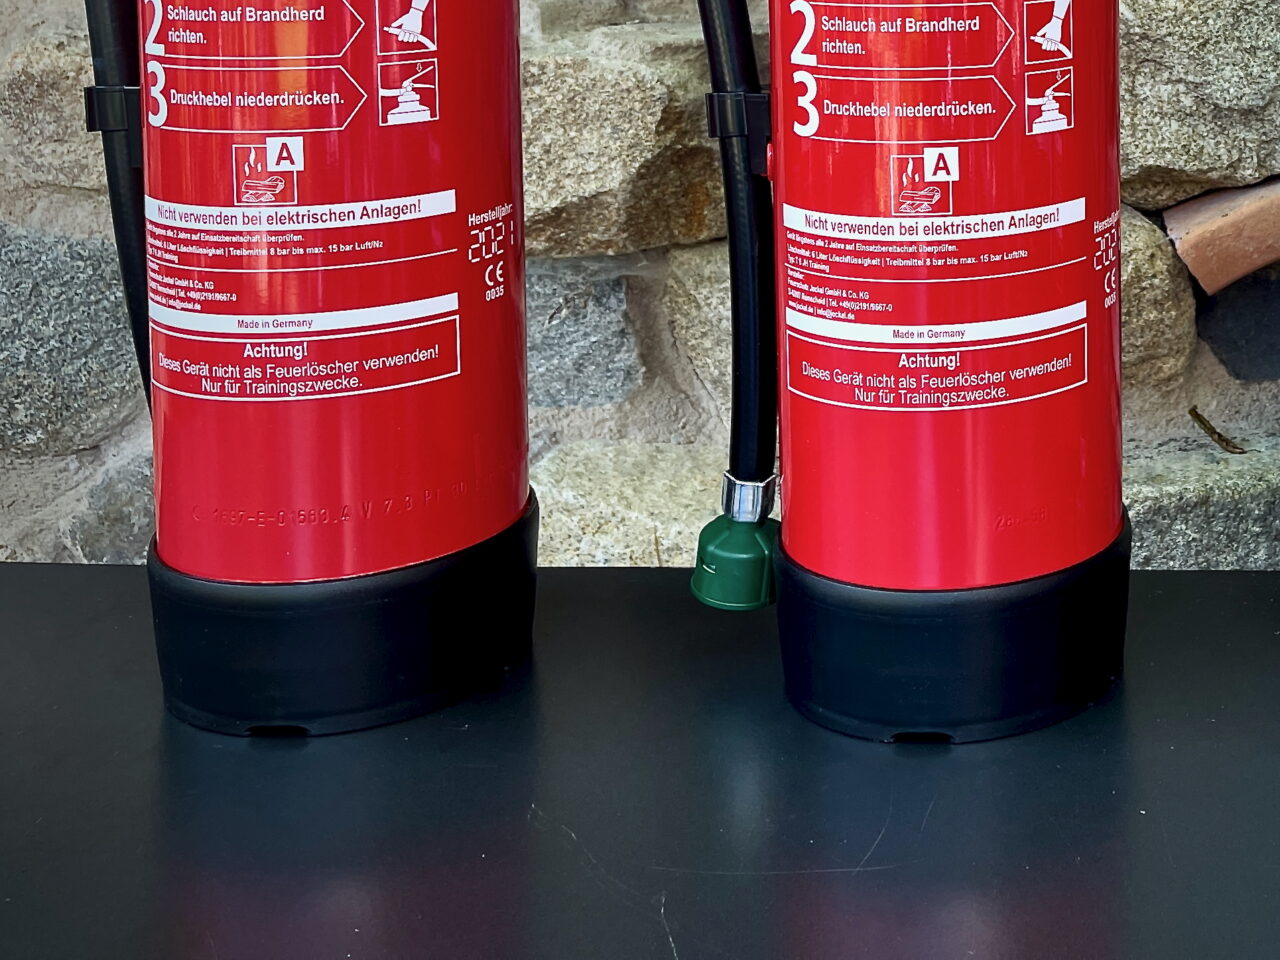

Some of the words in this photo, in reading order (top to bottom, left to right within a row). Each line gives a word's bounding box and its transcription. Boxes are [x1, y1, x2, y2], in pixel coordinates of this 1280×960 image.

[168, 5, 216, 21] Schlauch
[221, 7, 241, 21] auf
[246, 6, 324, 21] Brandherd
[790, 0, 819, 67] 2
[822, 16, 876, 32] Schlauch
[880, 18, 901, 32] auf
[906, 16, 979, 32] Brandherd
[169, 28, 206, 43] richten.
[822, 38, 865, 54] richten.
[145, 61, 169, 130] 3
[170, 89, 231, 106] Druckhebel
[236, 91, 344, 109] niederdrücken.
[793, 71, 822, 136] 3
[824, 100, 890, 118] Druckhebel
[893, 101, 995, 118] niederdrücken.
[276, 143, 295, 166] A
[932, 153, 951, 176] A
[158, 205, 176, 221] Nicht
[179, 211, 237, 225] verwenden
[243, 212, 261, 225] bei
[267, 209, 355, 225] elektrischen
[360, 199, 421, 219] Anlagen!
[805, 214, 828, 231] Nicht
[831, 222, 894, 235] verwenden
[899, 222, 919, 236] bei
[923, 219, 1004, 235] elektrischen
[1009, 208, 1059, 229] Anlagen!
[486, 285, 503, 301] 0035
[238, 320, 259, 328] Made
[272, 319, 313, 328] Germany
[893, 330, 914, 338] Made
[927, 330, 965, 339] Germany
[244, 342, 307, 360] Achtung!
[159, 352, 180, 372] Dieses
[183, 360, 209, 376] Gerät
[213, 364, 240, 378] nicht
[244, 365, 262, 378] als
[267, 360, 359, 378] Feuerlöscher
[363, 344, 438, 370] verwenden!
[899, 352, 960, 370] Achtung!
[803, 361, 830, 381] Dieses
[834, 369, 863, 386] Gerät
[867, 374, 895, 388] nicht
[899, 375, 916, 388] als
[921, 371, 1005, 388] Feuerlöscher
[1009, 354, 1071, 380] verwenden!
[202, 378, 221, 392] Nur
[224, 380, 240, 393] für
[244, 375, 362, 394] Trainingszwecke.
[855, 388, 876, 402] Nur
[879, 390, 895, 403] für
[898, 386, 1009, 405] Trainingszwecke.
